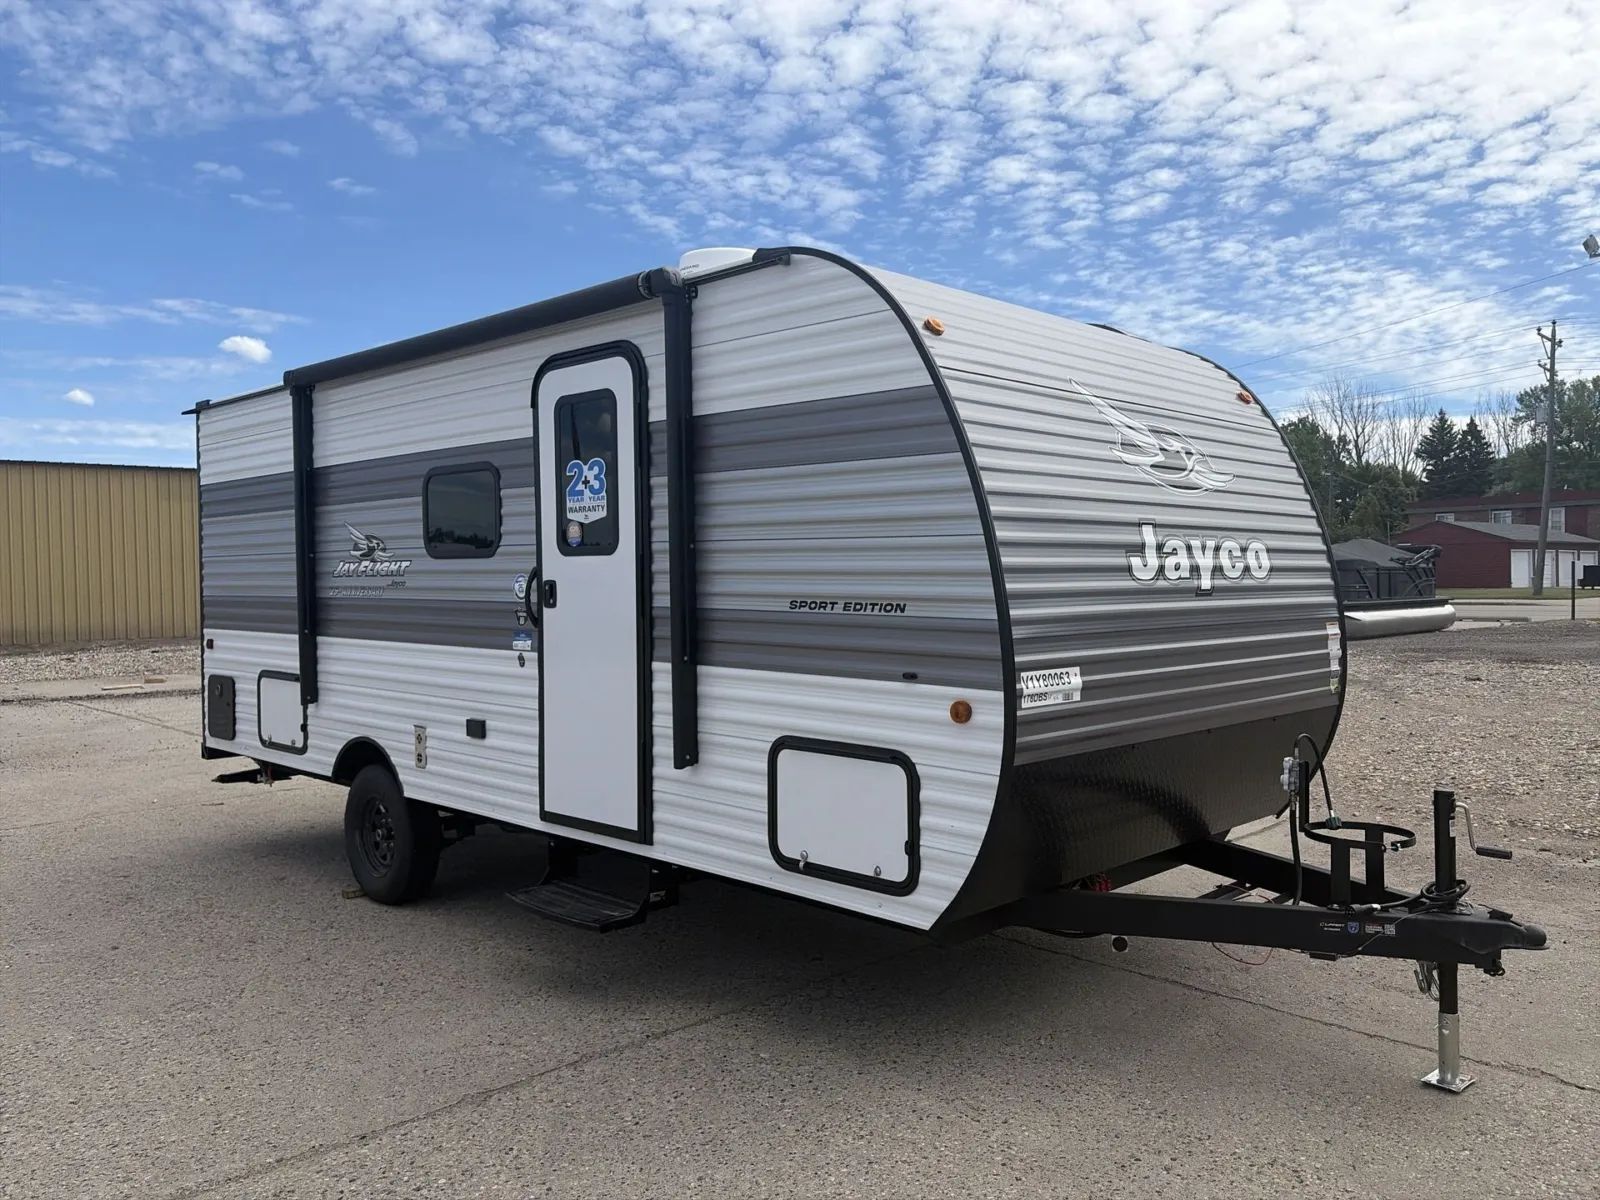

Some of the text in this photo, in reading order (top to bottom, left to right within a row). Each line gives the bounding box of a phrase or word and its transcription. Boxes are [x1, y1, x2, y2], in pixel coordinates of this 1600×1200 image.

[568, 495, 605, 504] YEAR YEAR
[568, 504, 605, 514] WARRANTY
[1127, 520, 1272, 594] Jayco
[333, 559, 412, 577] JAY FLIGHT
[788, 600, 907, 614] SPORT EDITION
[1021, 671, 1072, 690] V1Y80063
